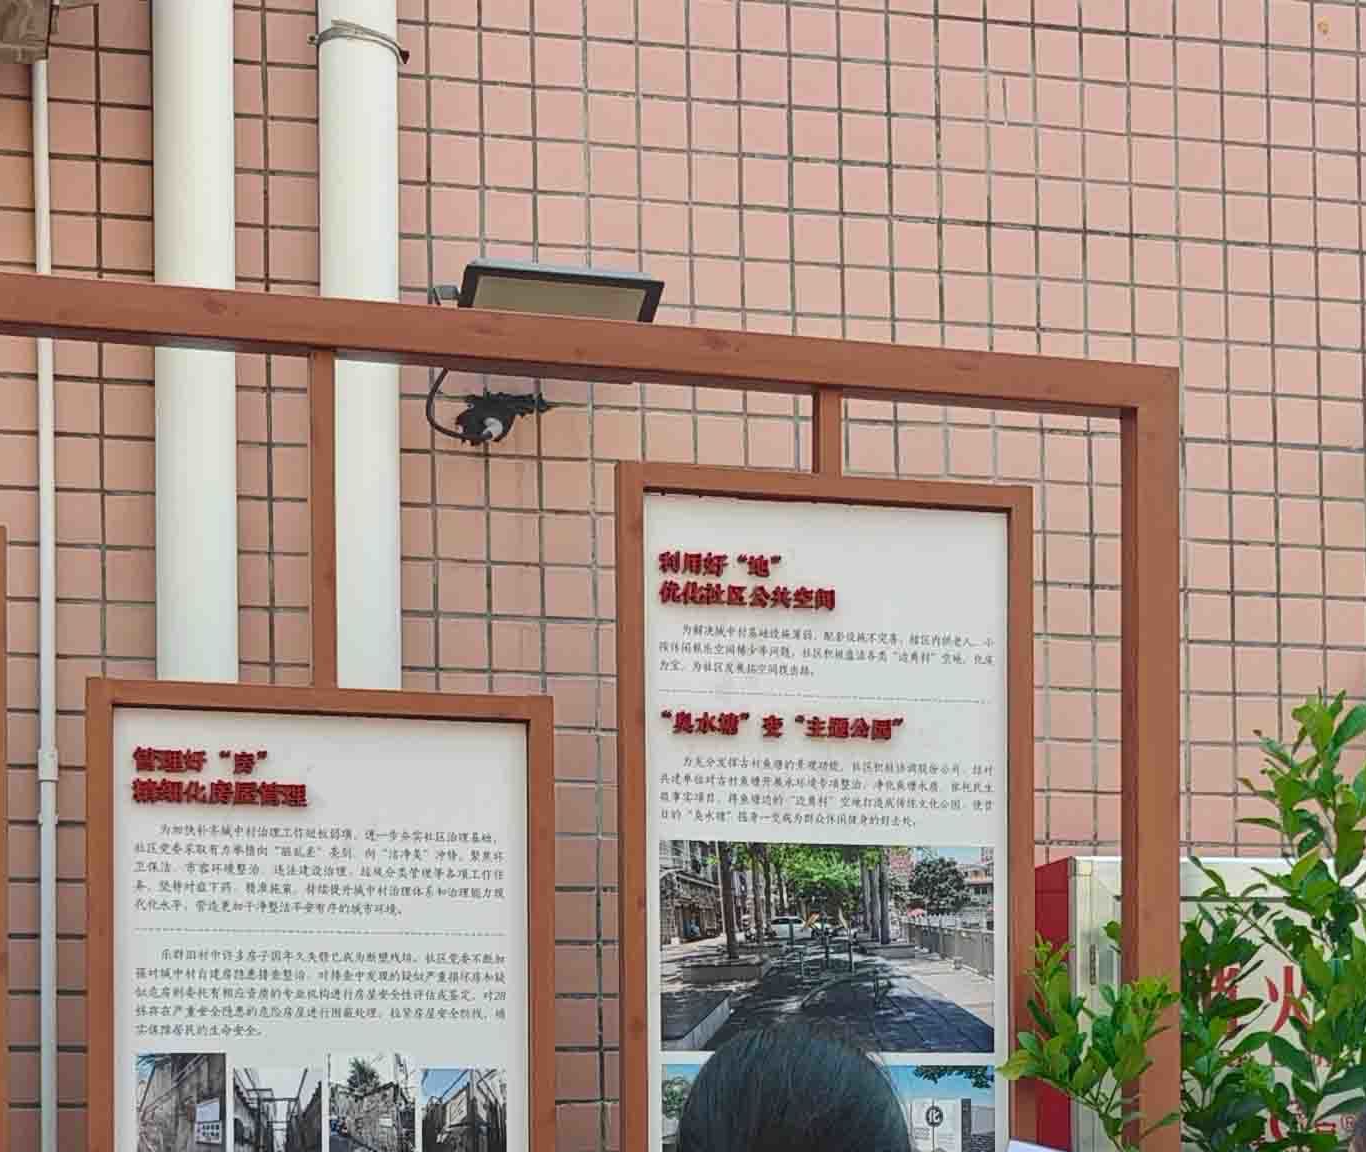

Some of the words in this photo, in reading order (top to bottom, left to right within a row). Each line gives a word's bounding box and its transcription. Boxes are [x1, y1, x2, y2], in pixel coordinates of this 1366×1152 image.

[658, 552, 782, 578] 利用好“地”
[658, 580, 836, 611] 优化社区公共空间
[132, 746, 269, 774] 管理好“房”
[132, 778, 308, 808] 精细化房屋管理
